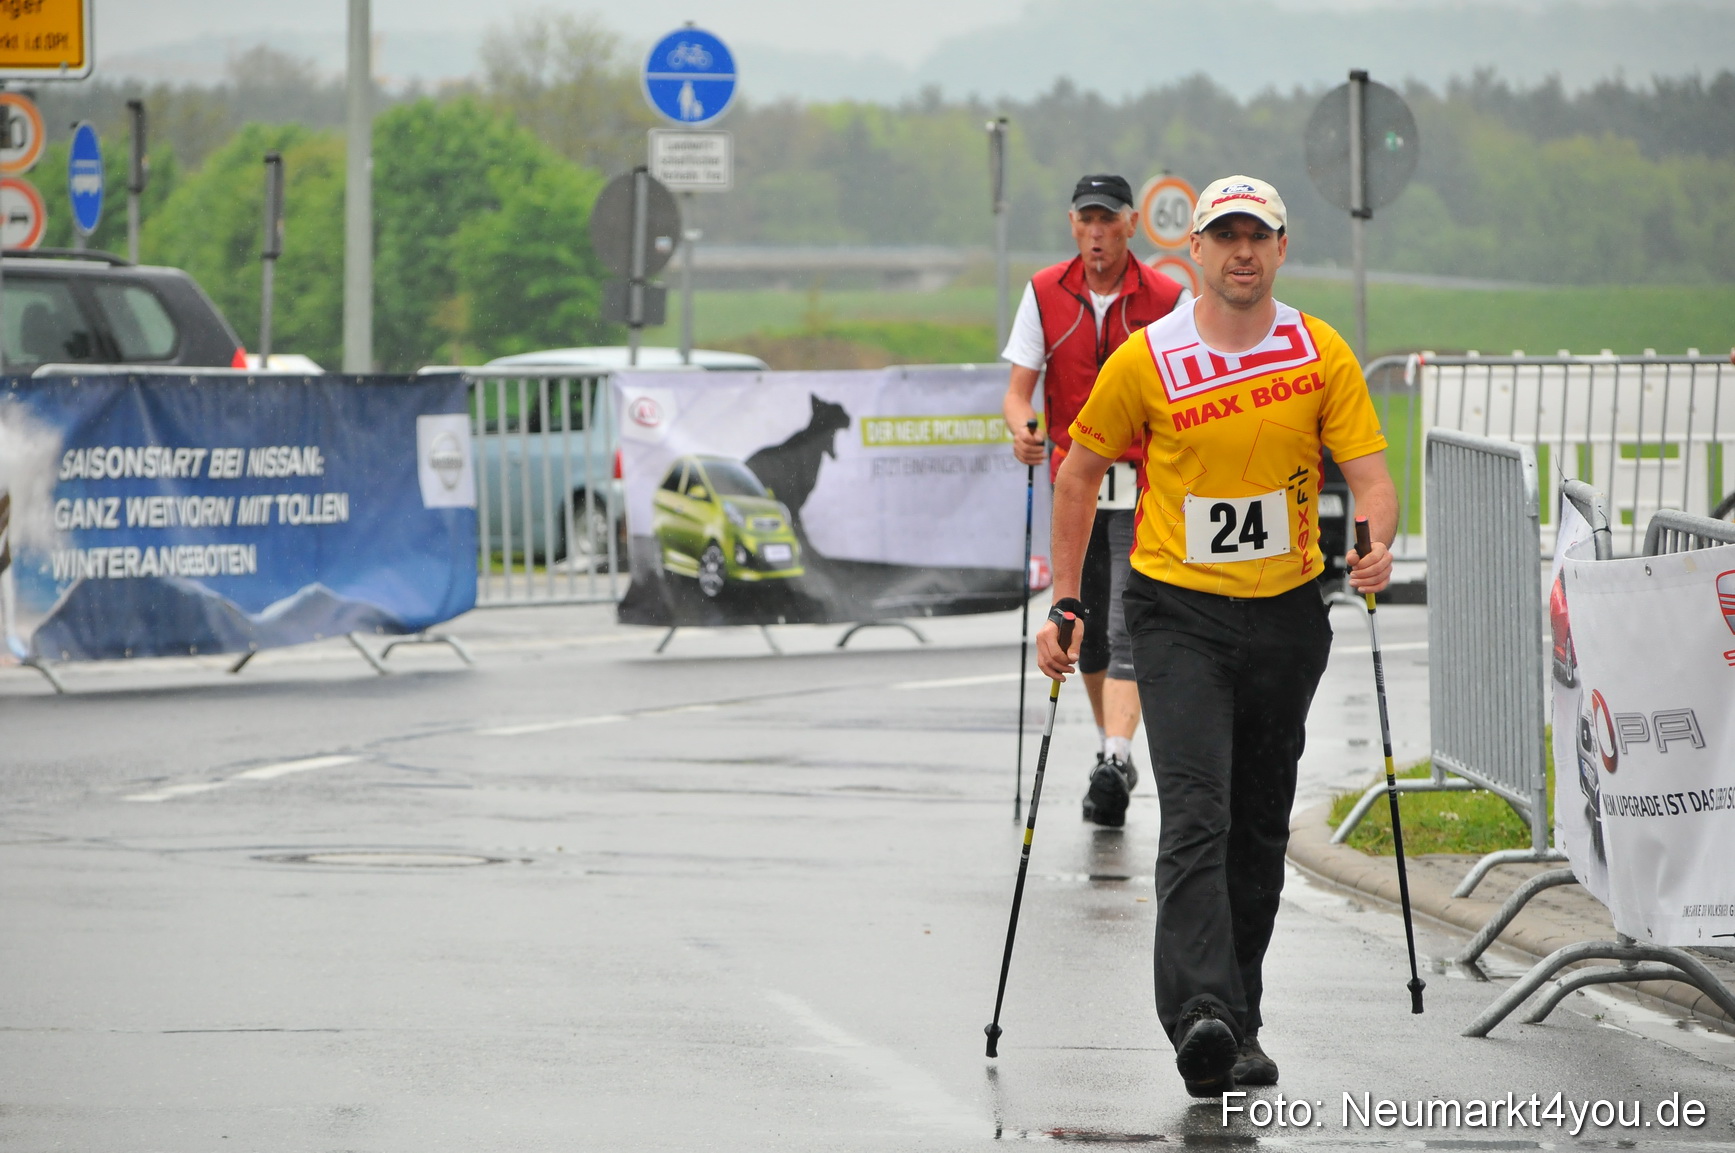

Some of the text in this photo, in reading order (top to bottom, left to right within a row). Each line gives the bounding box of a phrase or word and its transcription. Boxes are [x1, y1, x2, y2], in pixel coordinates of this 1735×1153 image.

[1153, 195, 1190, 228] 60
[1211, 193, 1267, 208] RACING
[1172, 372, 1325, 432] MAX BÖGL
[59, 445, 325, 480] SAISONSTART BEI NISSAN:
[54, 496, 121, 530] GANZ
[237, 495, 273, 526] MIT
[276, 492, 349, 526] TOLLEN
[1210, 500, 1268, 554] 24
[52, 543, 257, 581] WINTERANGEBOTEN
[1616, 795, 1664, 817] UPGRADE
[1662, 792, 1688, 816] IST
[1688, 788, 1715, 812] DAS
